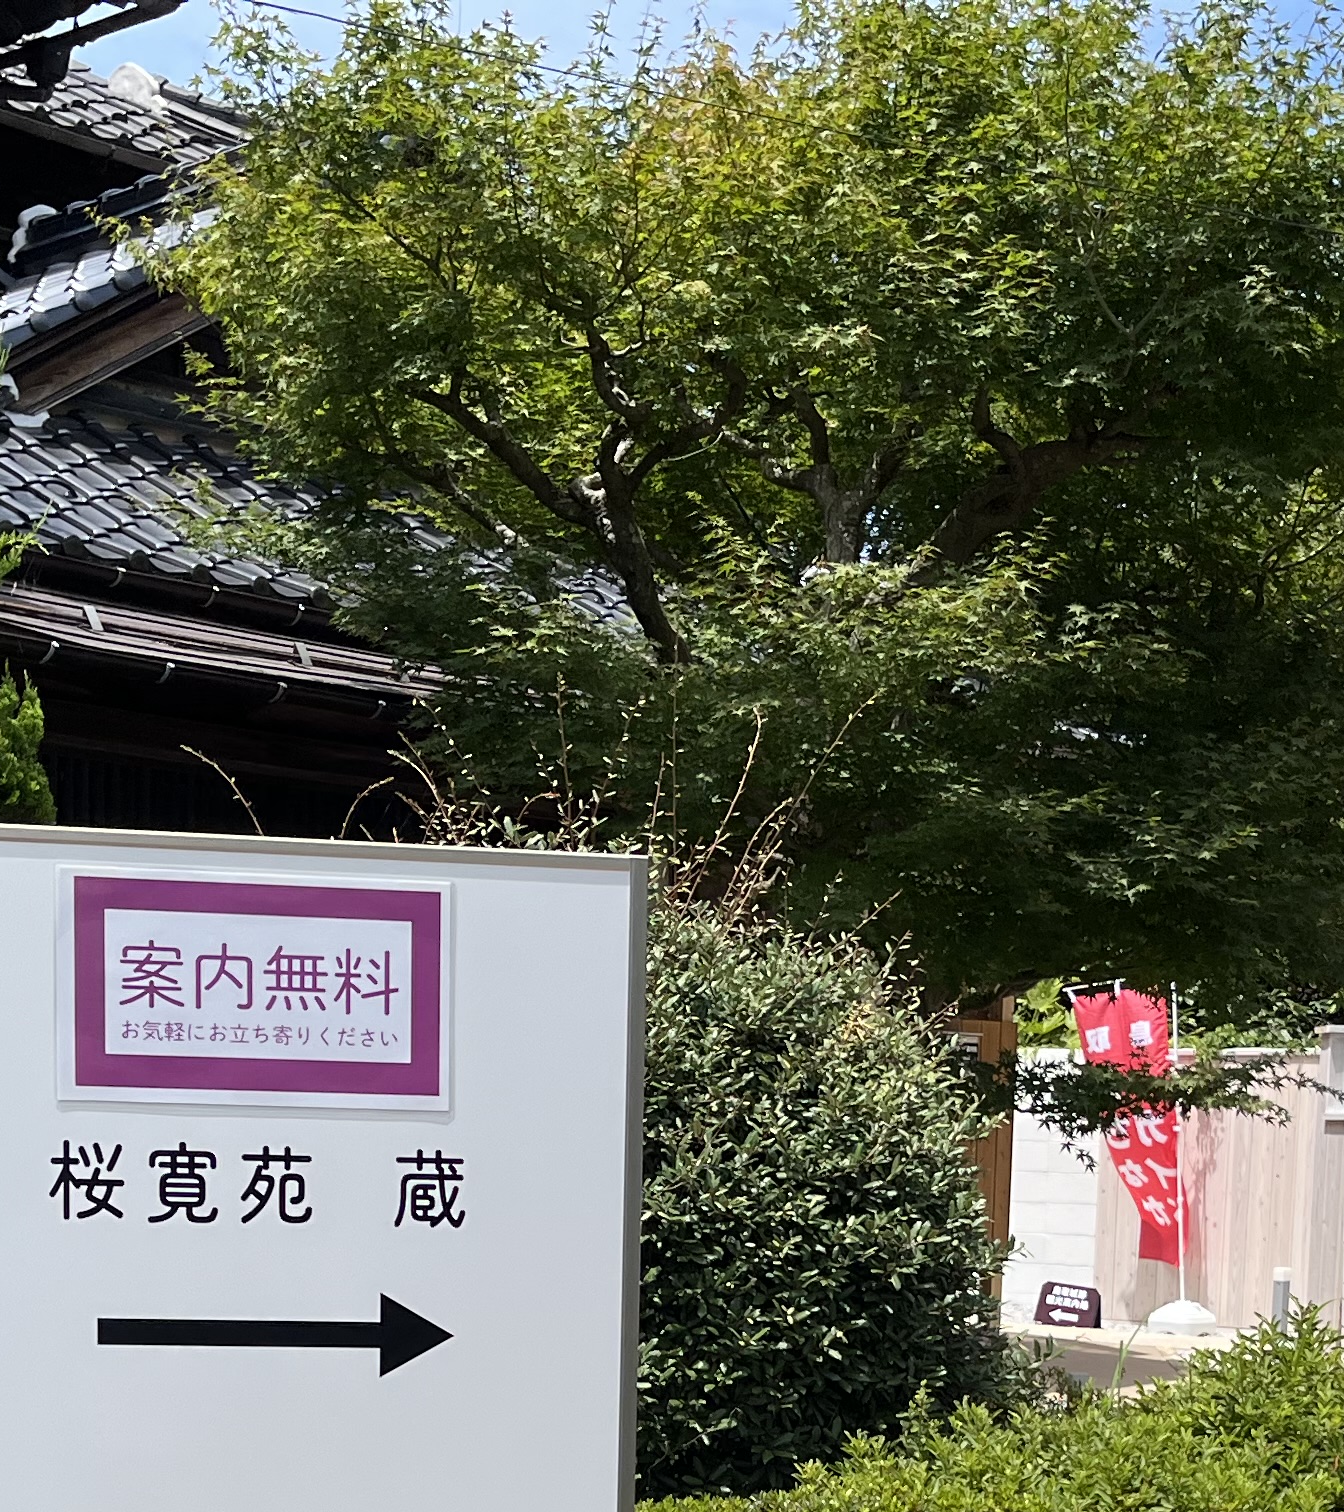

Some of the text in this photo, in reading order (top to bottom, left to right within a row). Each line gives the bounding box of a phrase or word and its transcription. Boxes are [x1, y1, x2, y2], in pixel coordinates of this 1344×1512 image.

[118, 939, 400, 1016] 案内無料
[120, 1019, 399, 1048] お気軽にお立ち寄りください
[48, 1139, 467, 1229] 桜寛苑 蔵
